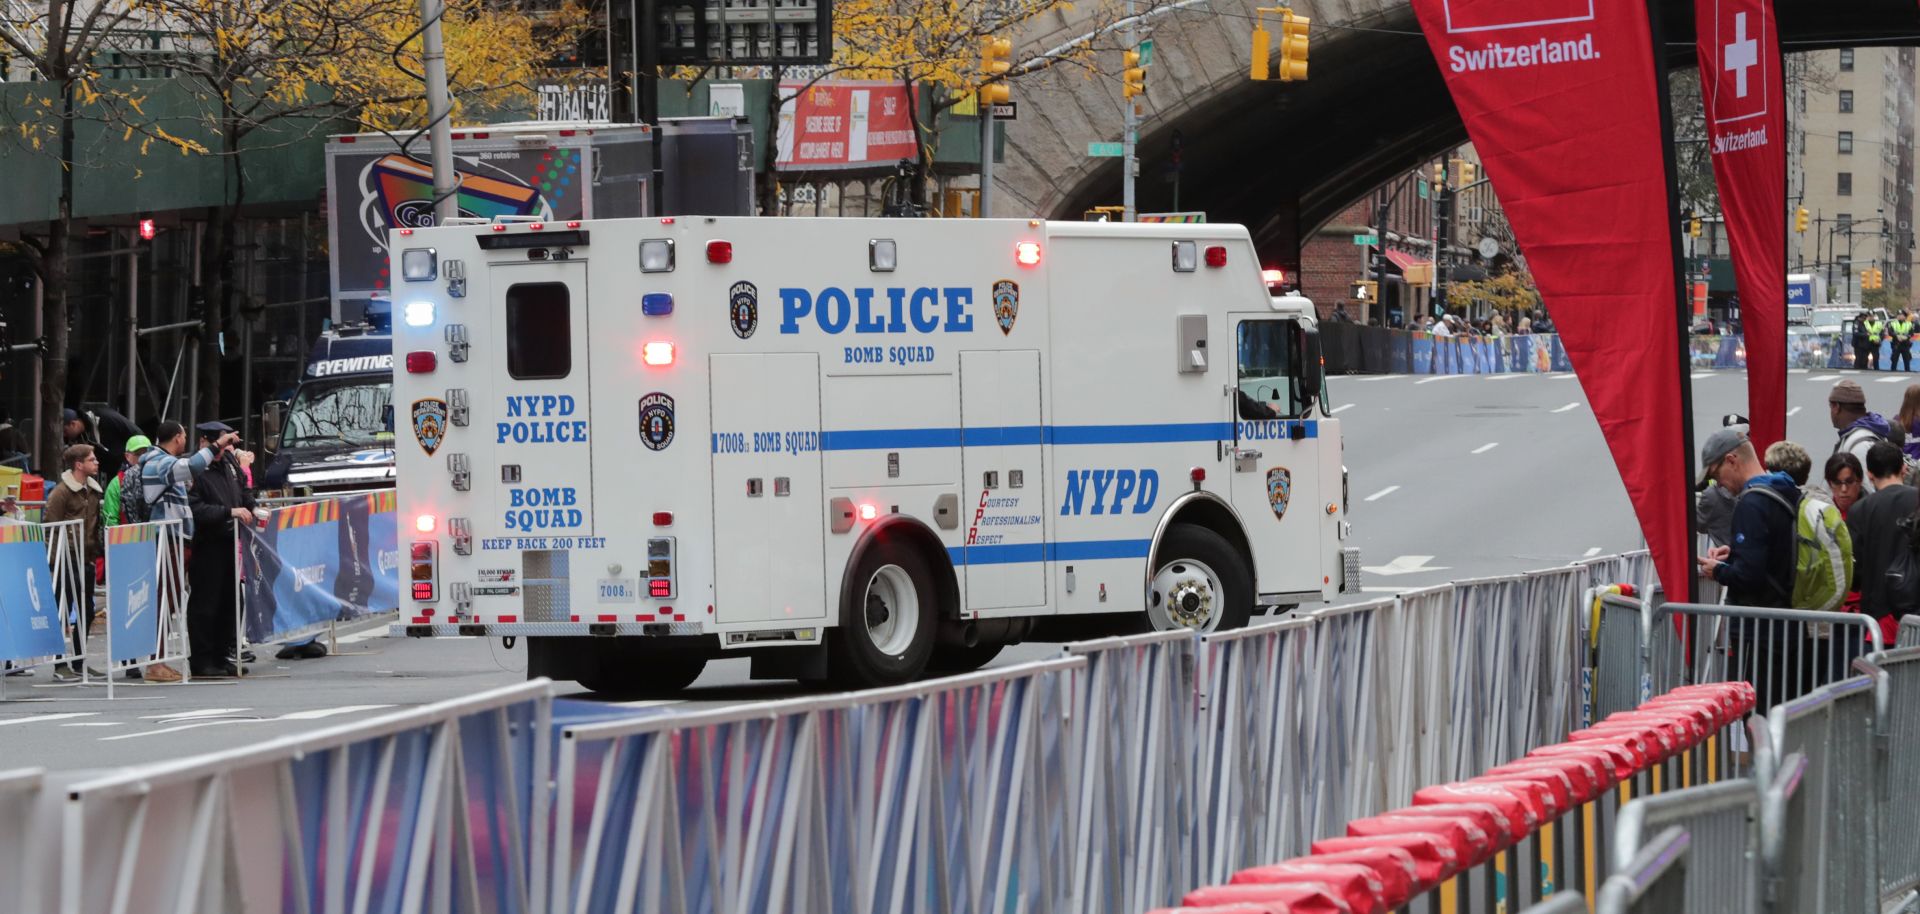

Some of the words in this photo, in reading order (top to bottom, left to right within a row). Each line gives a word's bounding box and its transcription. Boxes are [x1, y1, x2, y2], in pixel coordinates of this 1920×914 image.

[1450, 33, 1600, 73] Switzerland.
[1712, 124, 1768, 154] Switzerland.
[731, 284, 756, 300] POLICE
[779, 287, 974, 334] POLICE
[844, 347, 883, 364] BOMB
[890, 346, 935, 366] SQUAD
[506, 395, 574, 417] NYPD
[641, 395, 673, 411] POLICE
[648, 409, 666, 417] NYPD
[496, 421, 587, 444] POLICE
[1238, 421, 1286, 440] POLICE
[754, 432, 781, 452] BOMB
[786, 431, 817, 456] SQUAD
[510, 488, 576, 507] BOMB
[979, 491, 1019, 508] COURTESY
[1060, 469, 1159, 516] NYPD
[505, 509, 582, 532] SQUAD
[973, 509, 1040, 526] PROFESSIONALISM
[482, 539, 512, 550] KEEP
[517, 538, 548, 549] BACK
[552, 538, 573, 549] 200
[578, 537, 606, 548] FEET
[967, 528, 1003, 544] RESPECT
